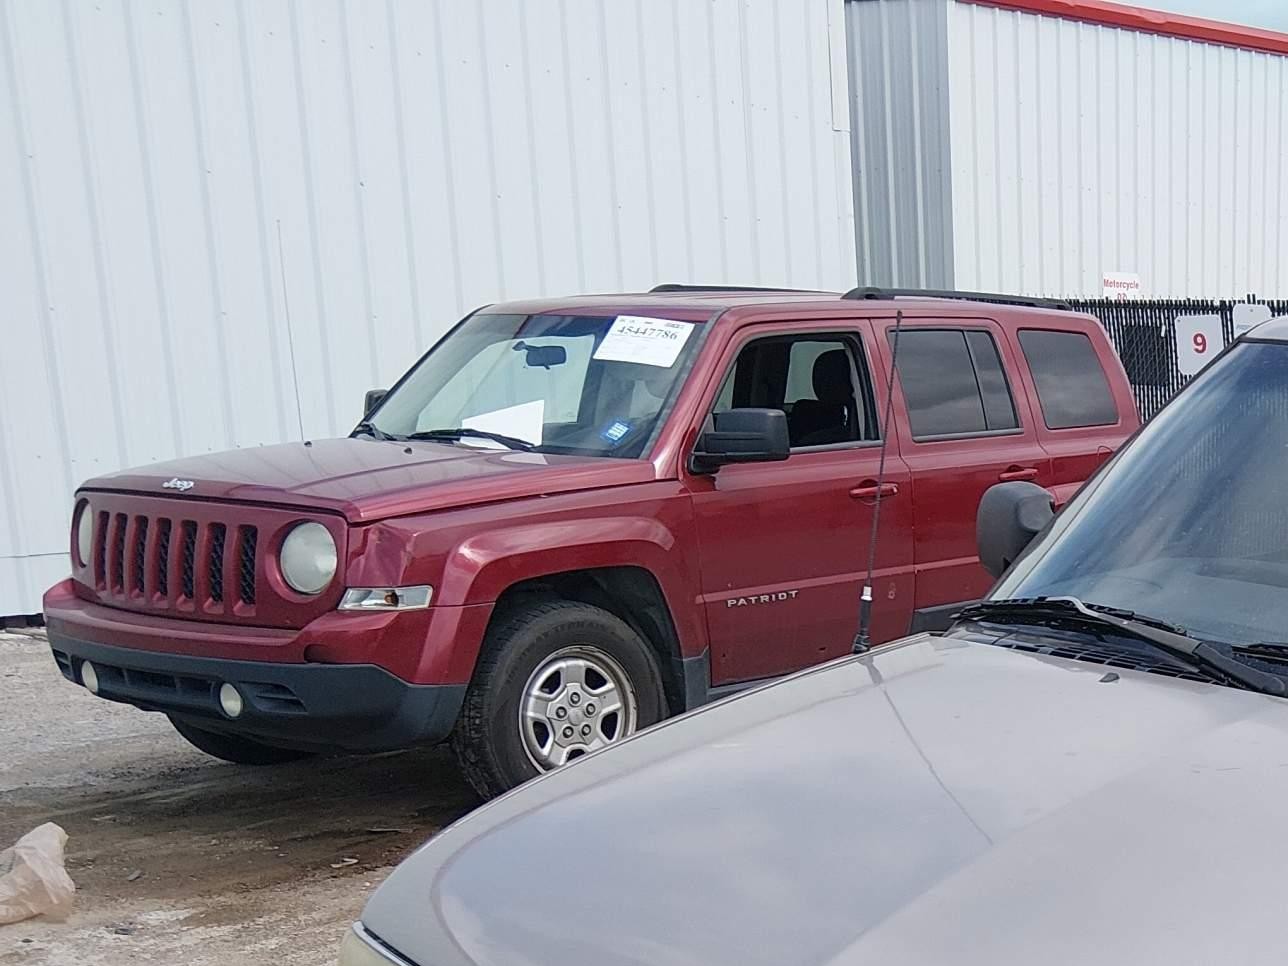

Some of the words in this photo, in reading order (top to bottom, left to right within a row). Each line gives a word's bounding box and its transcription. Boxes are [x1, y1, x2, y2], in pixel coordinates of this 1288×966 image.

[1103, 279, 1139, 290] Motorcycle
[617, 325, 678, 340] 45447786
[1193, 333, 1207, 354] 9
[162, 478, 194, 491] Jeep
[727, 590, 799, 608] PATRIOT
